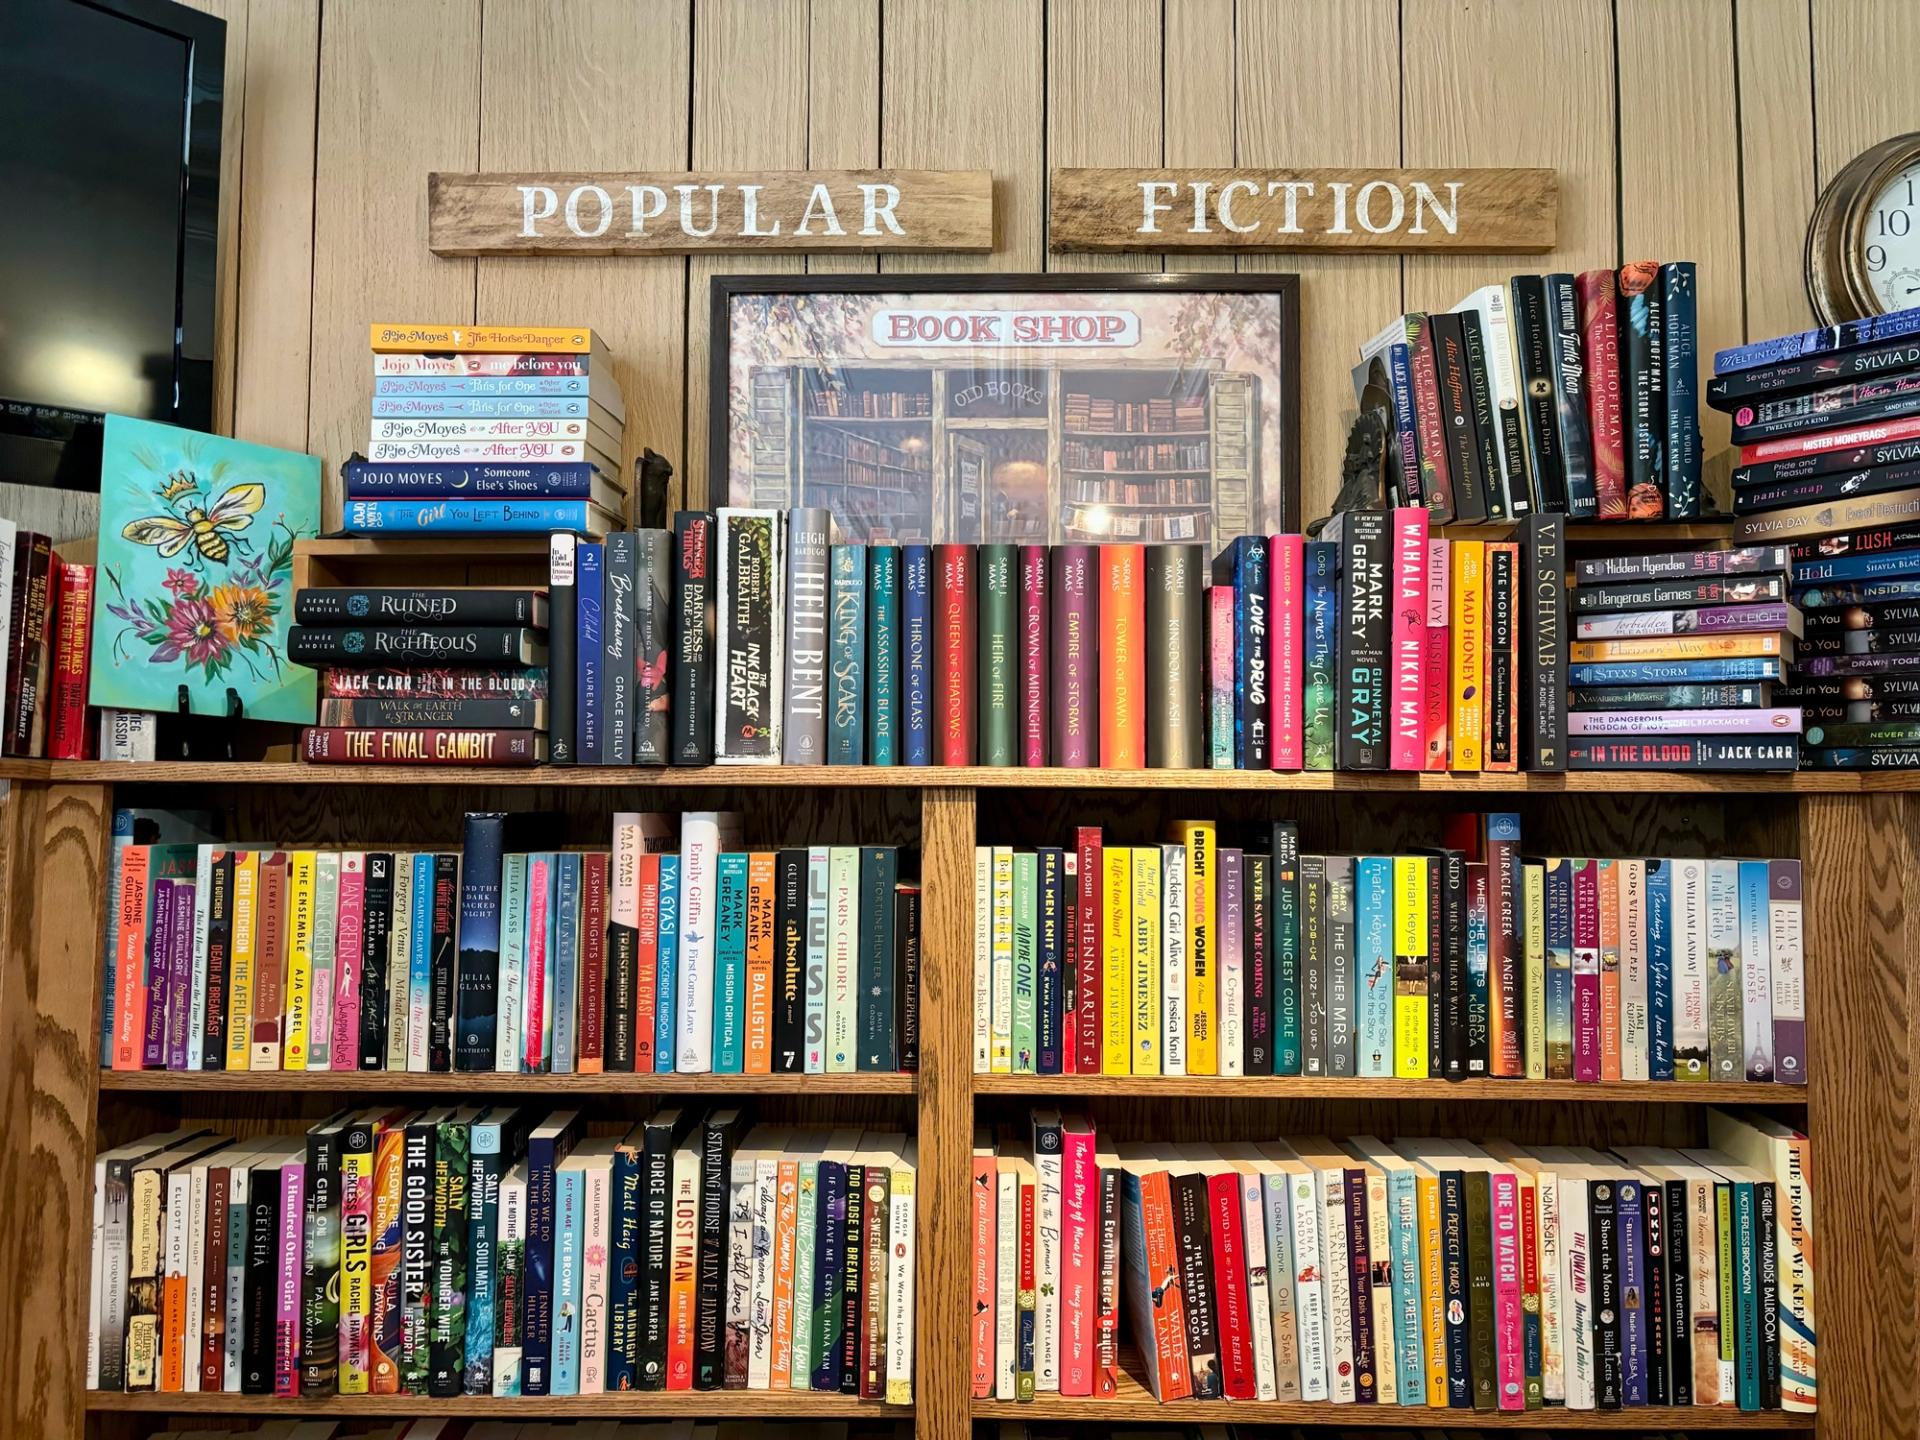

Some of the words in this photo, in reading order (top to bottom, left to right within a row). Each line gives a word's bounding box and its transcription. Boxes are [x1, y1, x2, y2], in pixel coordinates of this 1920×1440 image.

[516, 183, 906, 237] POPULAR
[1136, 181, 1464, 234] FICTION
[1879, 209, 1910, 236] 10
[1866, 245, 1886, 272] 9
[888, 314, 1000, 342] BOOK
[1013, 314, 1126, 342] SHOP
[1650, 302, 1660, 334] ALICE
[381, 330, 406, 343] Jojo
[407, 331, 448, 342] Moyes
[468, 332, 487, 349] The
[1558, 332, 1580, 362] Turtle
[382, 358, 410, 371] Jojo
[415, 358, 455, 371] Moyes
[513, 359, 554, 369] before
[557, 360, 581, 375] you
[1560, 363, 1582, 394] Moon
[1638, 370, 1649, 387] THE
[1650, 340, 1661, 392] HOFFMAN
[1746, 371, 1773, 382] Seven
[1778, 366, 1801, 377] Years
[1761, 381, 1769, 389] to
[1772, 378, 1785, 387] Sin
[954, 386, 984, 408] OLD
[987, 381, 1044, 406] BOOKS
[1637, 391, 1649, 417] STORY
[382, 422, 412, 438] Jojo
[414, 422, 466, 434] Moyes
[489, 422, 523, 434] After
[1638, 423, 1649, 460] SISTERS
[1803, 439, 1833, 451] MISTER
[1834, 429, 1887, 446] MONEYBAGS
[361, 472, 393, 484] JOJO
[398, 473, 442, 484] MOYES
[484, 468, 530, 477] Someone
[476, 480, 506, 491] Else's
[509, 480, 538, 491] Shoes
[417, 504, 446, 526] Girl
[473, 506, 499, 521] LEFT
[504, 506, 539, 521] BEHIND
[1538, 522, 1555, 539] V.
[1744, 520, 1784, 534] SYLVIA
[1787, 517, 1809, 529] DAY
[1538, 544, 1555, 563] E.
[1856, 532, 1892, 550] LUSH
[1402, 524, 1421, 598] WAHALA
[1498, 555, 1507, 585] KATE
[1799, 565, 1833, 580] Hold
[737, 533, 751, 625] GALBRAITH
[751, 557, 760, 601] ROBERT
[1353, 544, 1366, 639] GREANEY
[1369, 563, 1382, 619] MARK
[1599, 588, 1650, 607] Dangerous
[1654, 585, 1691, 600] Games
[381, 596, 457, 614] RUINED
[608, 572, 632, 660] Breakaway
[792, 571, 824, 640] HELL
[1463, 590, 1475, 624] MAD
[1498, 591, 1507, 645] MORTON
[1538, 570, 1555, 666] SCHWAB
[1699, 614, 1735, 625] LORA
[1739, 612, 1779, 622] LEIGH
[949, 603, 960, 648] QUEEN
[747, 643, 760, 669] INK
[911, 617, 922, 670] THRONE
[1463, 629, 1475, 683] HONEY
[336, 675, 369, 690] JACK
[378, 675, 411, 690] CARR
[443, 677, 453, 690] IN
[461, 677, 481, 690] THE
[489, 678, 524, 690] BLOOD
[731, 650, 745, 710] HEART
[1402, 640, 1419, 691] NIKKI
[614, 676, 624, 715] GRACE
[747, 673, 759, 717] BLACK
[792, 648, 822, 719] BENT
[911, 691, 922, 730] GLASS
[950, 672, 960, 739] SHADOWS
[1352, 668, 1369, 745] GRAY
[1372, 668, 1381, 746] GUNMETAL
[1401, 701, 1417, 739] MAY
[345, 731, 375, 758] THE
[382, 732, 427, 758] FINAL
[436, 732, 497, 759] GAMBIT
[614, 720, 624, 760] REILLY
[1591, 746, 1605, 761] IN
[1610, 746, 1638, 761] THE
[1643, 745, 1691, 761] BLOOD
[1719, 746, 1752, 759] JACK
[1759, 746, 1792, 759] CARR
[688, 843, 702, 882] Emily
[1045, 854, 1055, 886] REAL
[1194, 831, 1204, 877] BRIGHT
[238, 870, 250, 894] BETH
[298, 865, 308, 887] THE
[1501, 846, 1510, 898] MIRACLE
[688, 887, 701, 925] Giffin
[1045, 889, 1054, 916] MEN
[1195, 879, 1205, 923] YOUNG
[1686, 881, 1696, 929] WILLIAM
[236, 899, 249, 952] GUTCHEON
[297, 891, 308, 952] ENSEMBLE
[1044, 920, 1054, 950] KNIT
[1502, 902, 1512, 936] CREEK
[687, 949, 698, 971] First
[1195, 926, 1205, 977] WOMEN
[1687, 932, 1697, 972] LANDAY
[236, 960, 247, 981] THE
[294, 969, 304, 991] AJA
[1503, 956, 1512, 991] ANGIE
[687, 974, 697, 1007] Comes
[1504, 996, 1513, 1019] KIM
[1582, 989, 1593, 1025] desire
[233, 985, 247, 1051] AFFLICTION
[293, 996, 303, 1033] GABEL
[686, 1009, 696, 1034] Love
[1582, 1028, 1593, 1055] lines
[407, 1136, 426, 1171] THE
[1788, 1147, 1801, 1179] THE
[650, 1154, 666, 1194] FORCE
[286, 1185, 297, 1238] Hundred
[407, 1176, 425, 1224] GOOD
[650, 1201, 664, 1216] OF
[1498, 1183, 1511, 1207] ONE
[1499, 1213, 1513, 1230] TO
[1740, 1191, 1749, 1245] MOTHERLESS
[1789, 1185, 1802, 1247] PEOPLE
[284, 1242, 296, 1277] Other
[405, 1231, 424, 1293] SISTER
[649, 1220, 664, 1269] NATURE
[1102, 1220, 1115, 1275] Everything
[1500, 1236, 1515, 1282] WATCH
[1742, 1247, 1752, 1294] BROOKLYN
[1792, 1252, 1804, 1278] WE
[283, 1281, 295, 1311] Girls
[1102, 1279, 1113, 1303] Here
[1102, 1306, 1113, 1315] Is
[1101, 1320, 1112, 1369] Beautiful
